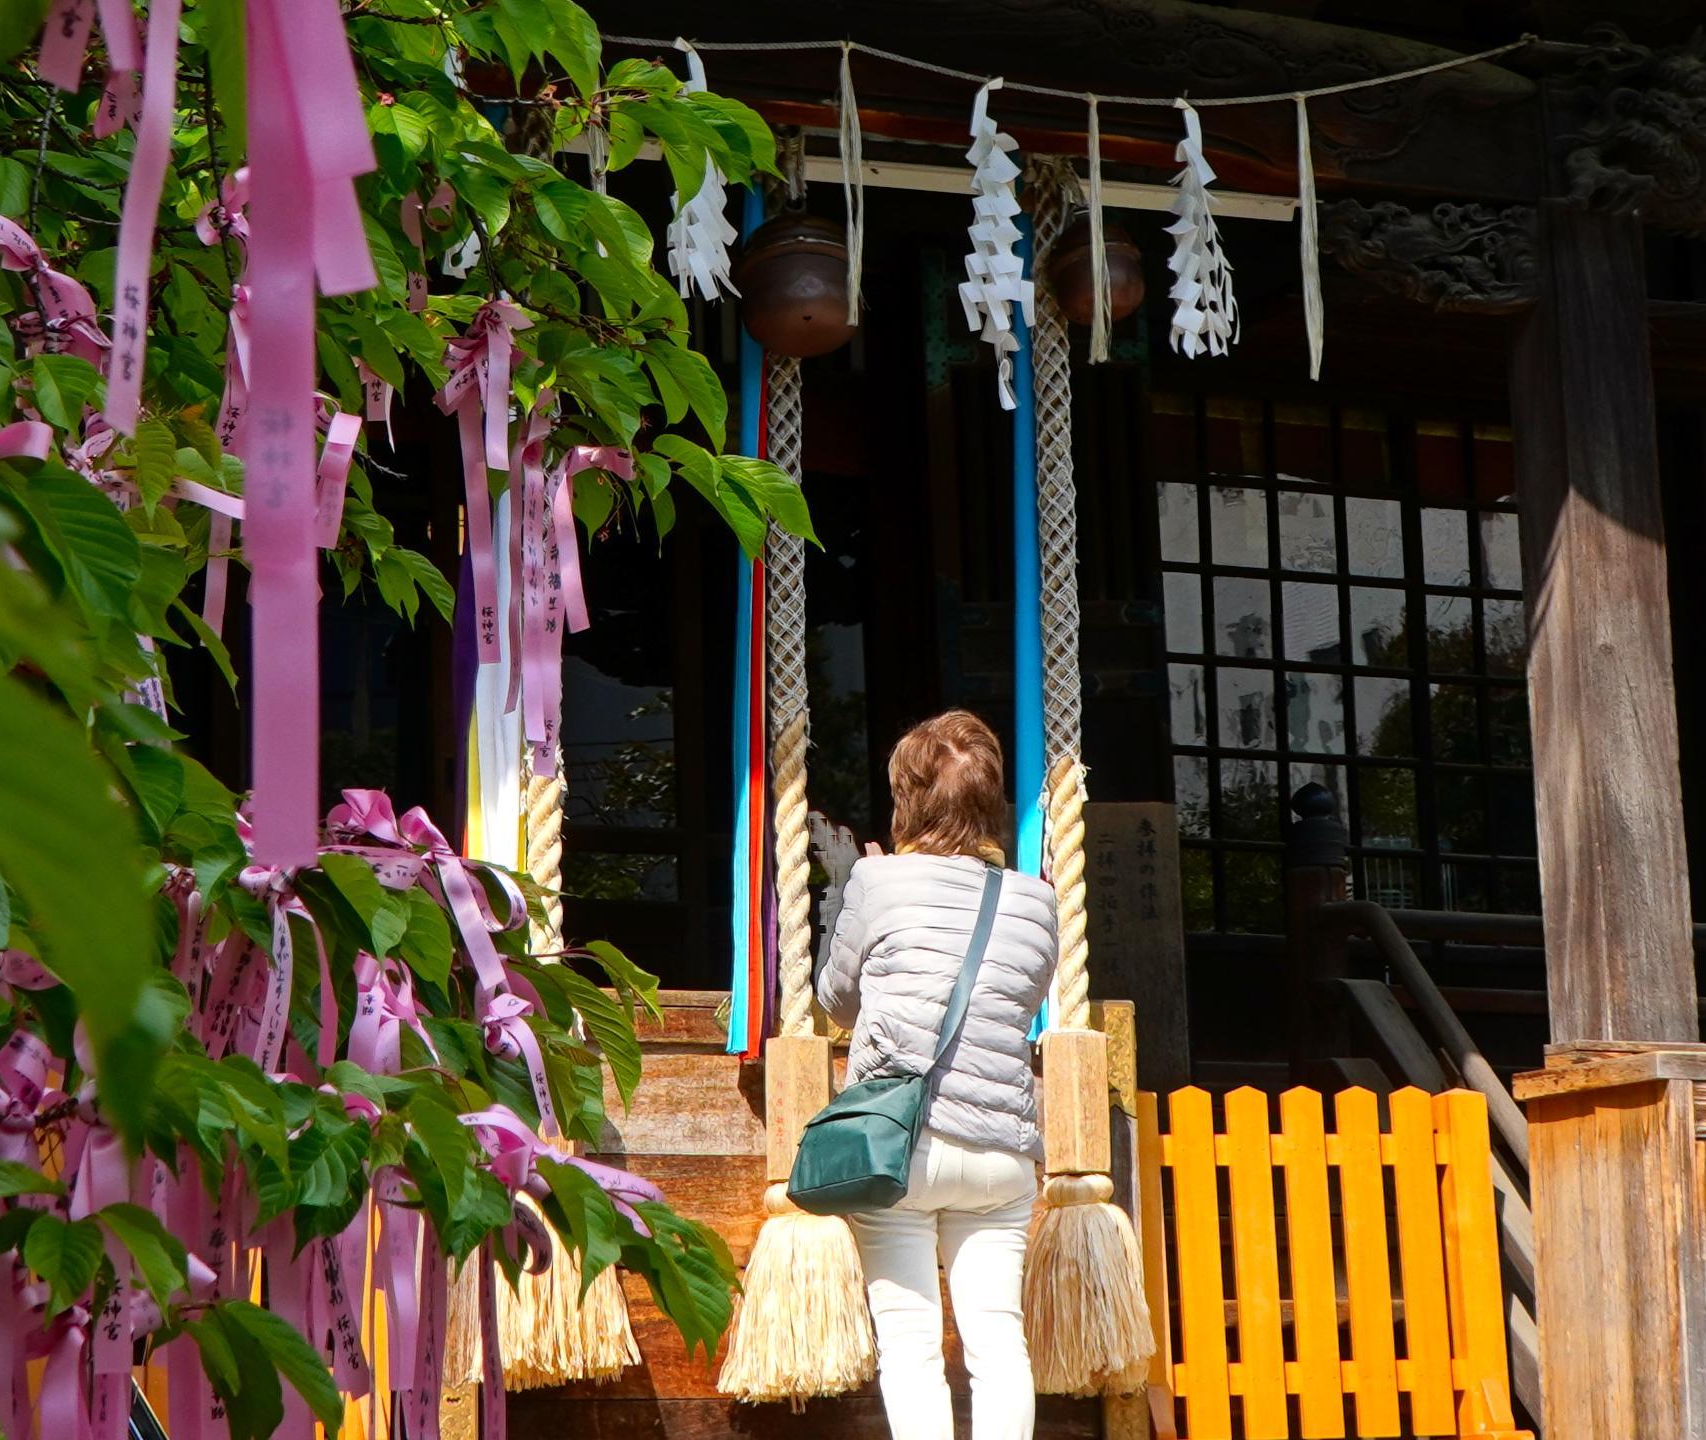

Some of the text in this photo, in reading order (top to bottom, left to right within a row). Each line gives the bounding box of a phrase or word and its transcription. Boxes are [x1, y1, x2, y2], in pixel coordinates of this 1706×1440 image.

[122, 284, 140, 381] 桜神宮
[221, 406, 240, 447] 桜神宮
[482, 606, 494, 645] 桜神宮
[536, 1071, 550, 1115] 桜神宮
[338, 1313, 359, 1370] 桜神宮
